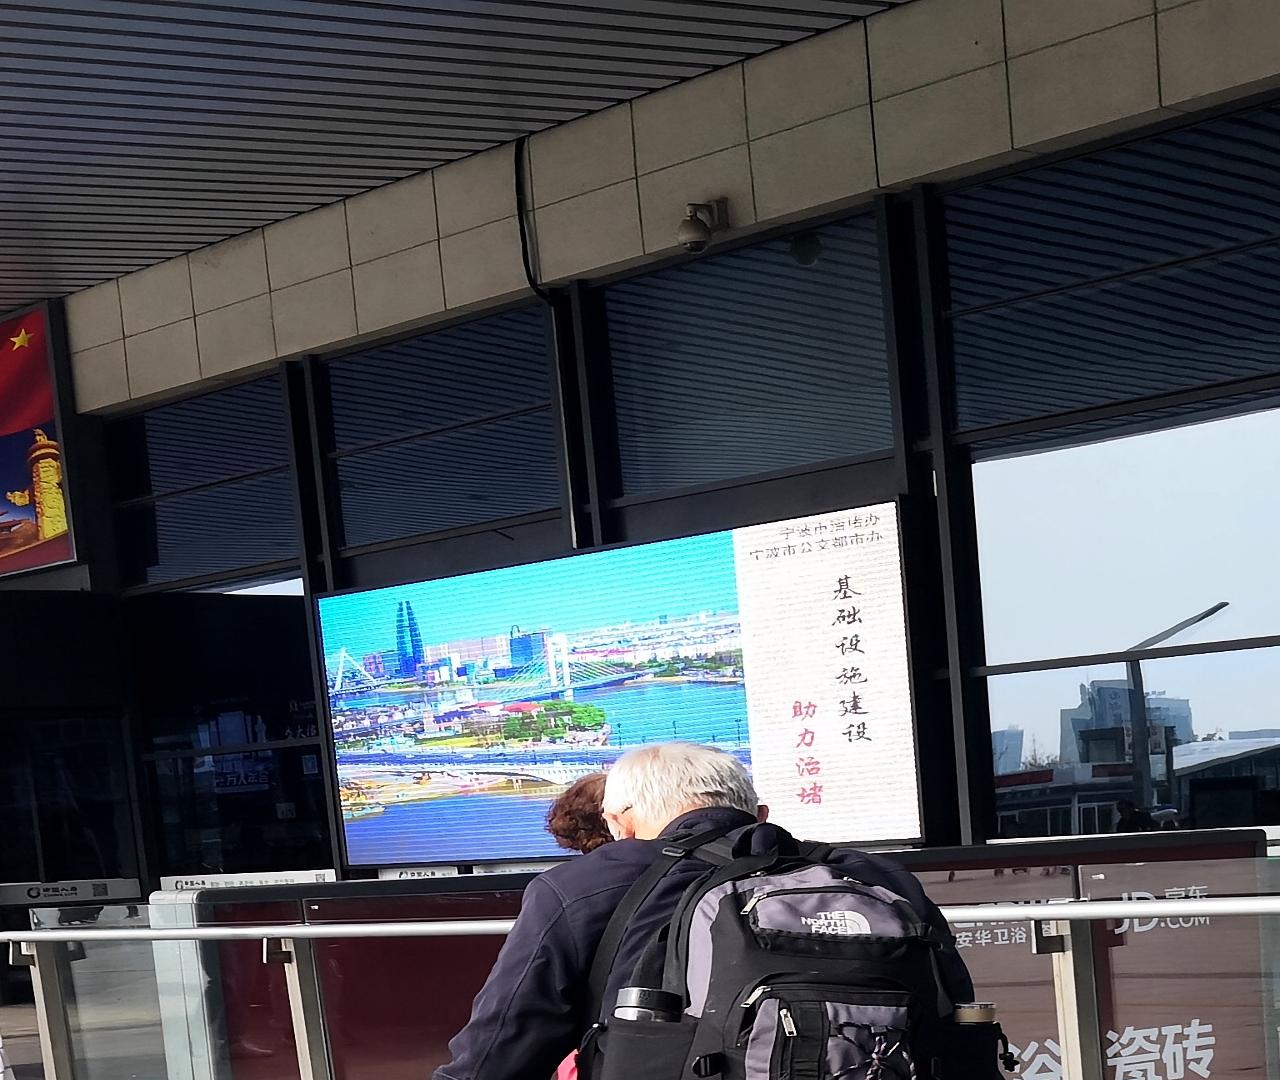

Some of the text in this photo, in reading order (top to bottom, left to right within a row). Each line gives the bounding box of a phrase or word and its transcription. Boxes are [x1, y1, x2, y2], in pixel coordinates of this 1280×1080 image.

[831, 574, 872, 743] 基础设施建设
[792, 700, 824, 805] 助力治堵
[800, 916, 846, 928] NORTH
[817, 911, 845, 920] THE
[811, 925, 848, 935] FACE
[955, 926, 1027, 948] 安华卫浴
